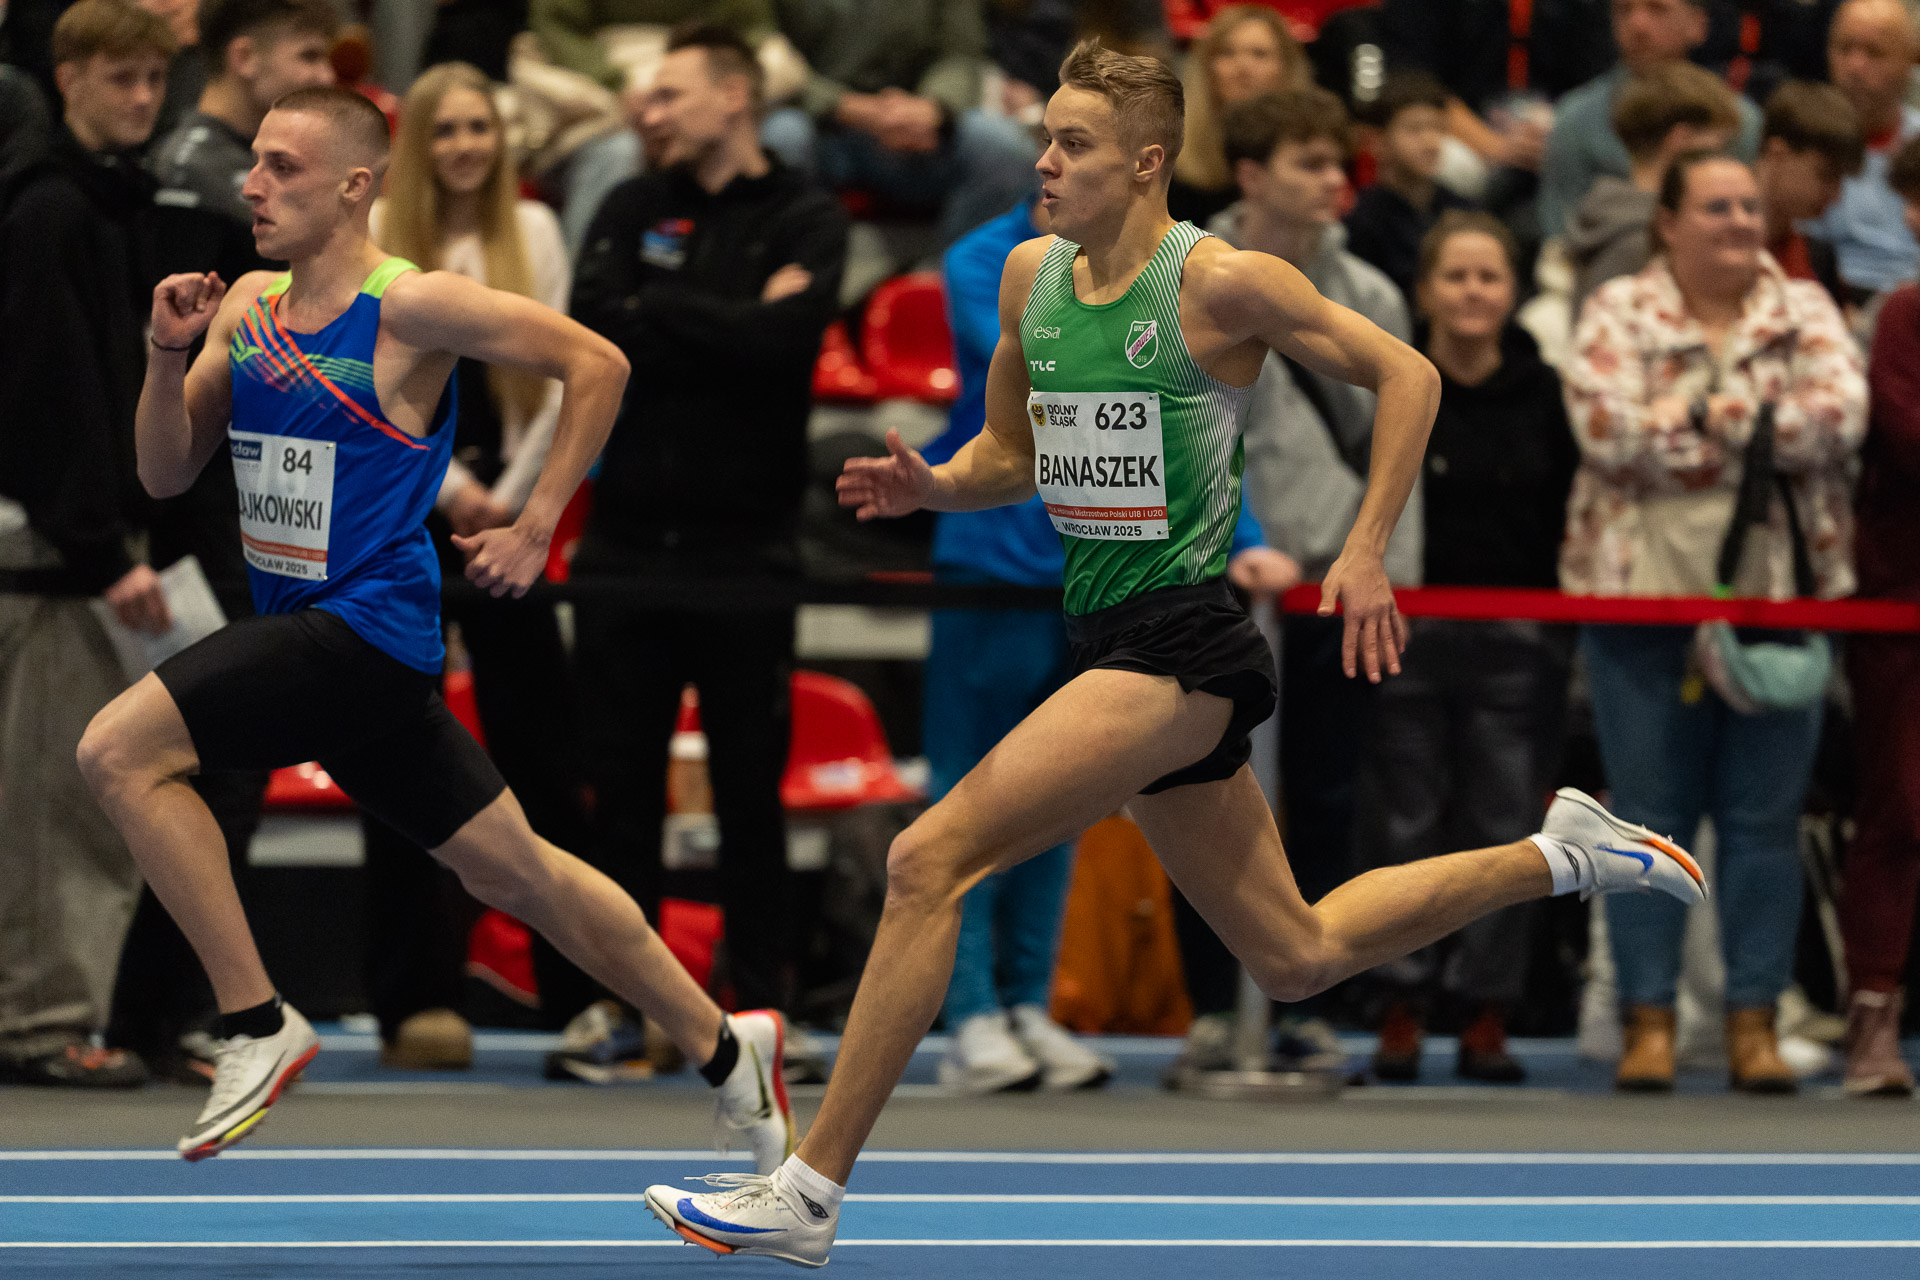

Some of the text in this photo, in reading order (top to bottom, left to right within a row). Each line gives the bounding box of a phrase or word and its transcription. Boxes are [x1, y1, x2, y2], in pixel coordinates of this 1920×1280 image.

[1034, 326, 1061, 339] esa
[1030, 360, 1057, 372] TLC
[1047, 404, 1079, 416] DOLNY
[1095, 402, 1147, 430] 623
[282, 447, 313, 475] 84
[1040, 454, 1160, 488] BANASZEK
[1074, 509, 1109, 518] Mistrzostwa
[1128, 510, 1142, 518] U18
[1147, 509, 1164, 517] U20
[1062, 522, 1142, 537] WROCŁAW 2025
[285, 561, 308, 575] 2025
